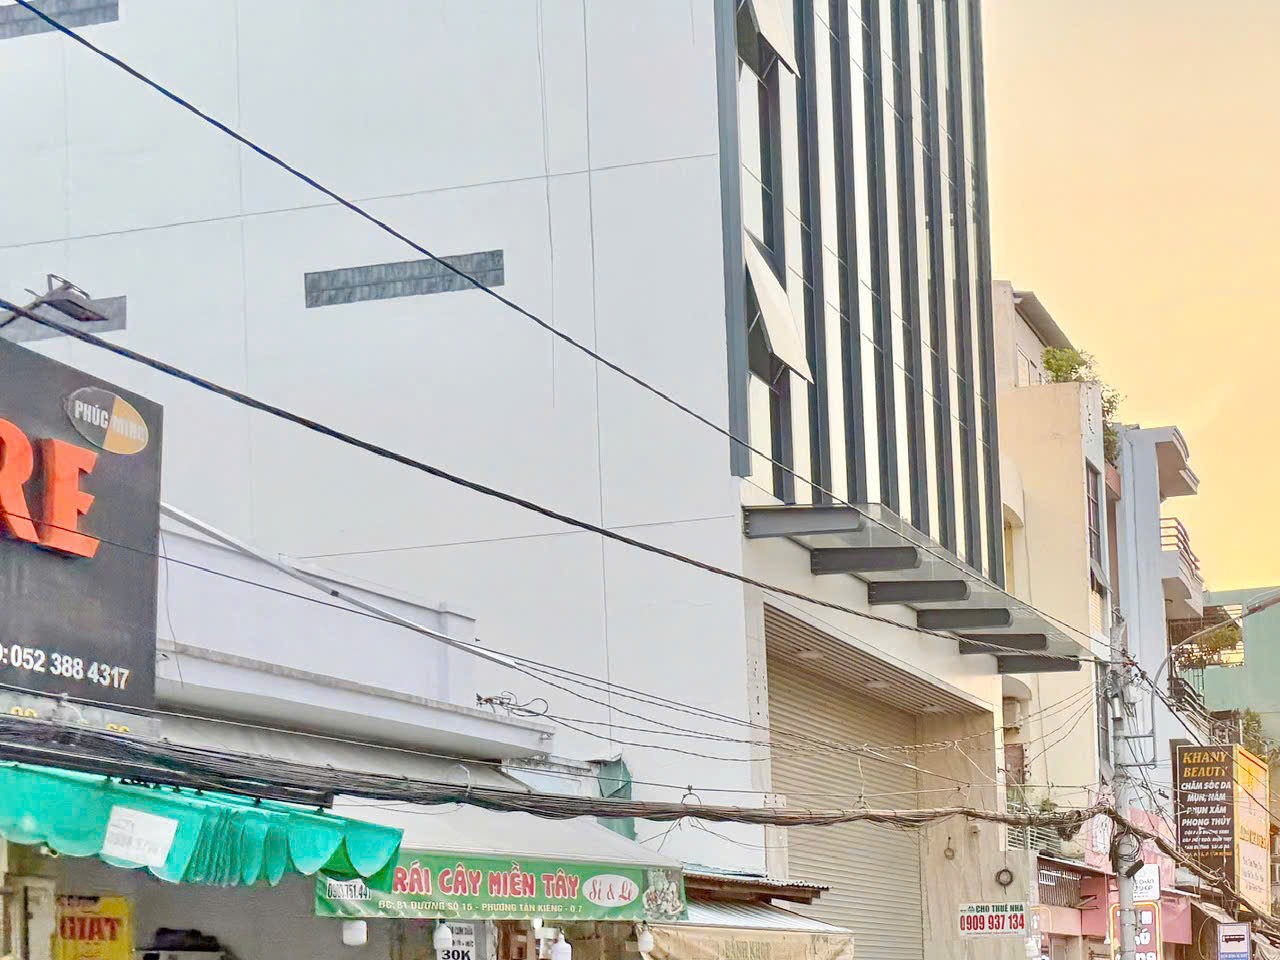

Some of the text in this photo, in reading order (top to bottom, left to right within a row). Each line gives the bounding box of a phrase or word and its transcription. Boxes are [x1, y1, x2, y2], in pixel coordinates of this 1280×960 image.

[74, 399, 109, 429] PHÚC
[10, 644, 46, 673] 052
[51, 653, 84, 680] 388
[87, 661, 130, 690] 4317
[1183, 751, 1228, 764] KHANY
[1183, 766, 1228, 778] BEAUTY
[1204, 780, 1220, 790] SÓC
[1220, 781, 1232, 789] DA
[1181, 818, 1210, 827] PHONG
[393, 860, 580, 900] RÁI CÂY MIỀN TÂY
[975, 905, 990, 913] CHO
[991, 904, 1008, 913] THUÊ
[960, 913, 1025, 931] 0909 937 134
[441, 949, 471, 960] 30K
